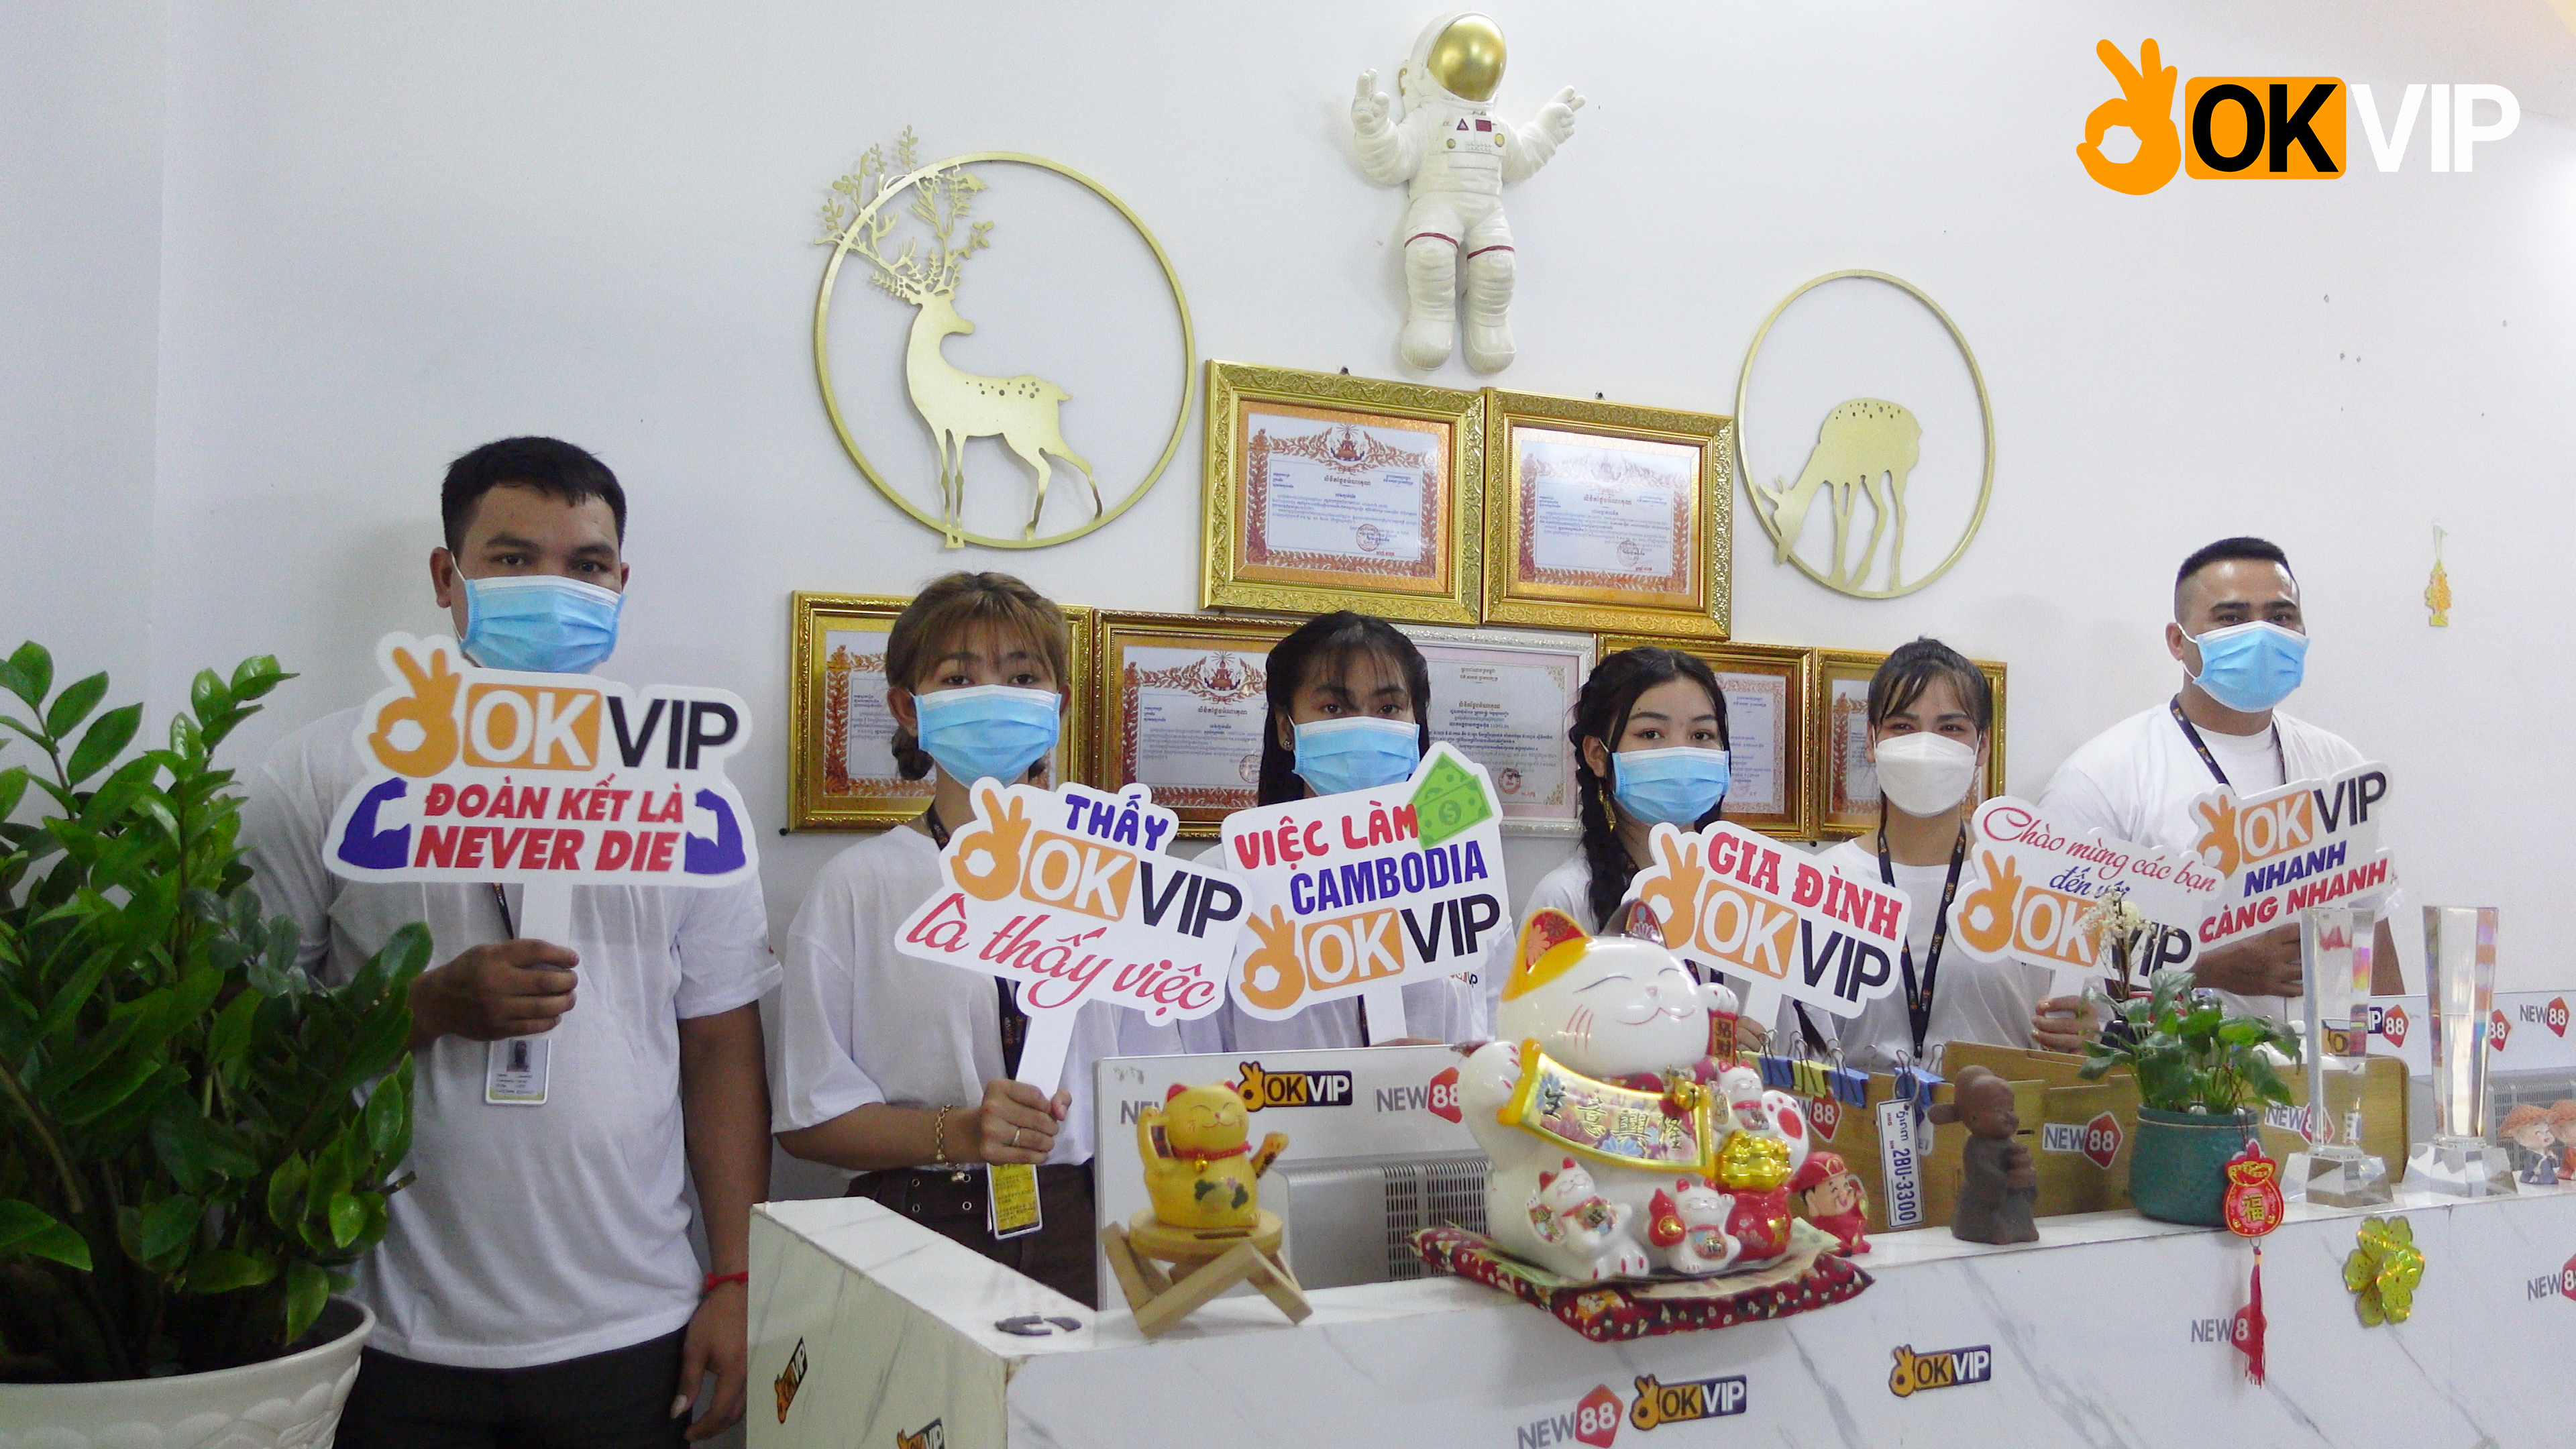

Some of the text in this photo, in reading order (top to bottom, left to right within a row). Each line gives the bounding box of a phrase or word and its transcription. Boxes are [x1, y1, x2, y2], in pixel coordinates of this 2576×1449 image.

[424, 773, 684, 824] ĐOÀN KẾT LÀ
[1065, 794, 1169, 851] THẤY
[414, 825, 681, 871] NEVER DIE
[1234, 800, 1418, 870] VIỆC LÀM
[1983, 806, 2216, 894] Chào mừng các bạn
[2243, 840, 2347, 898] NHANH
[1290, 840, 1488, 915] CAMBODIA
[1708, 832, 1902, 941] GIA ĐÌNH
[2049, 866, 2092, 897] đến
[2199, 857, 2387, 943] CÀNG NHANH
[906, 893, 1216, 1016] là thấy việc
[1892, 1148, 1917, 1221] 2BU-3300
[2241, 1193, 2265, 1222] 福
